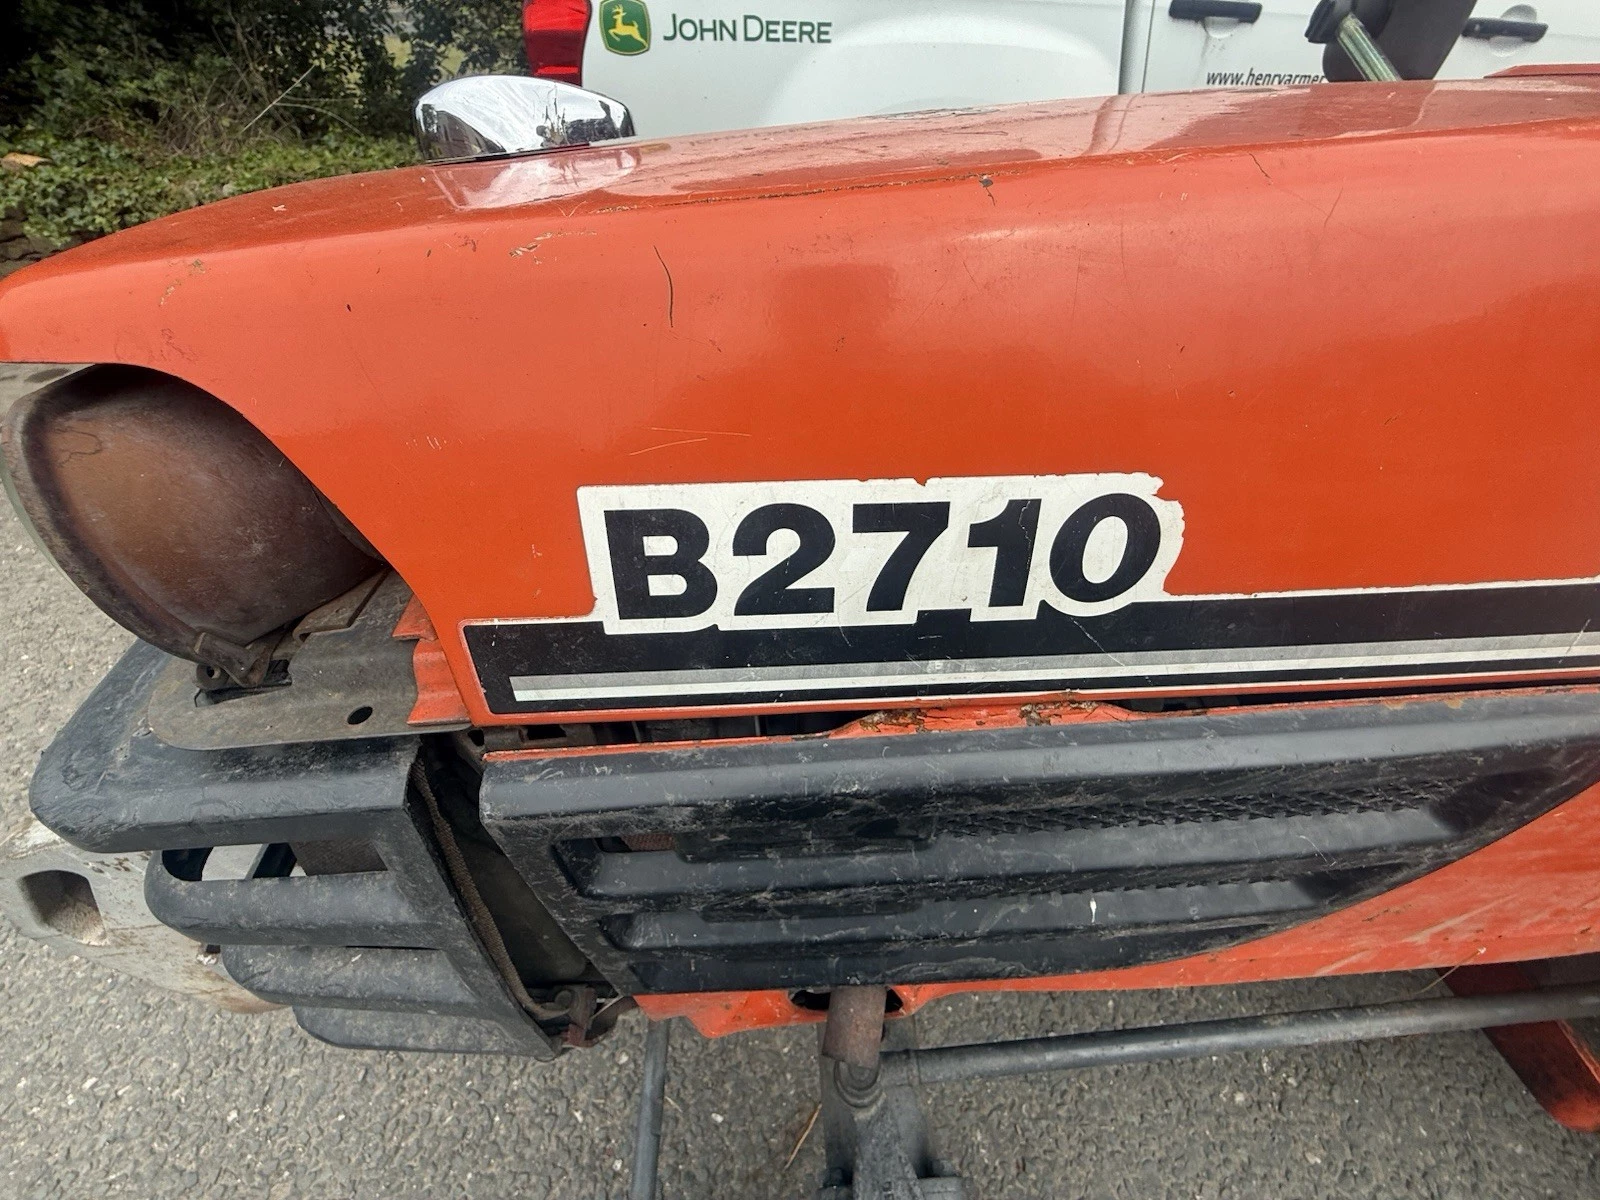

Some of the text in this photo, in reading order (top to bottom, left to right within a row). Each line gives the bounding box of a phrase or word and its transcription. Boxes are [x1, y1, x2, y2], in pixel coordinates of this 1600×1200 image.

[663, 13, 832, 43] JOHN DEERE
[603, 492, 1162, 620] B2710
